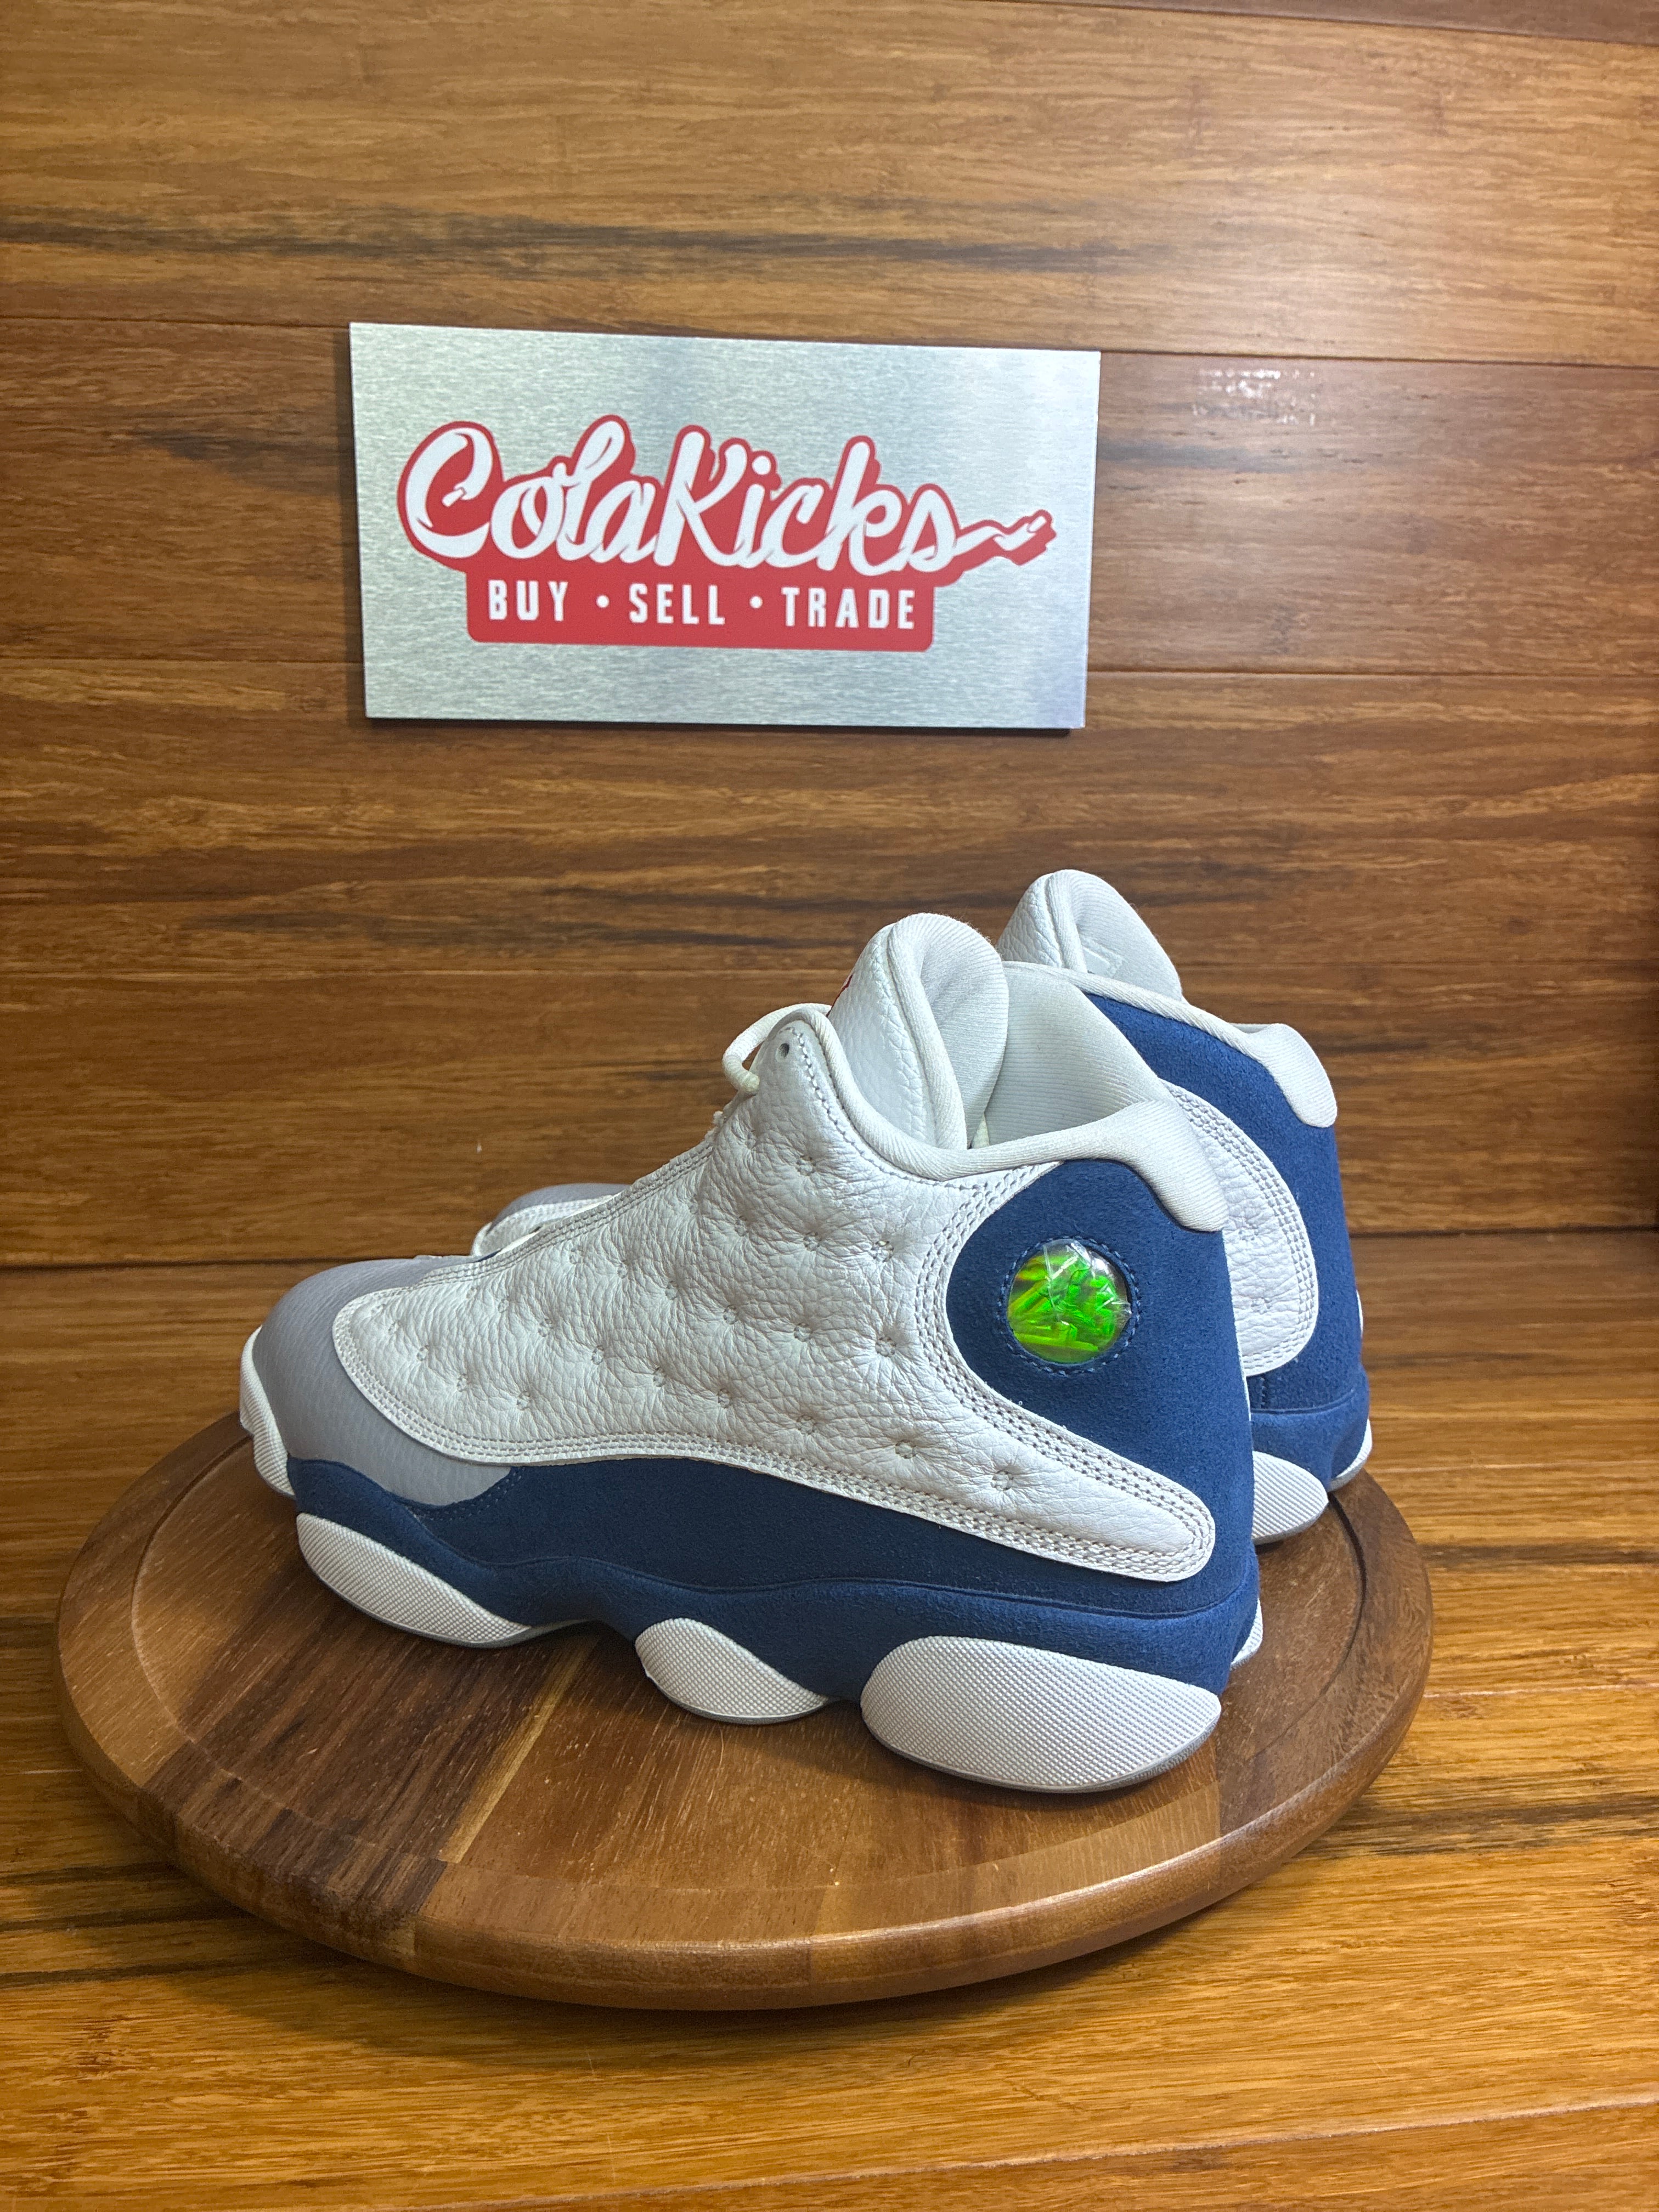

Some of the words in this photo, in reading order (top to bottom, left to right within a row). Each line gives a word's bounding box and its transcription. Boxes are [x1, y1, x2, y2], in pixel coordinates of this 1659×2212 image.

[404, 419, 1047, 577] ColaKicks
[488, 579, 569, 622] BUY
[628, 582, 726, 626] SELL
[780, 586, 916, 630] TRADE
